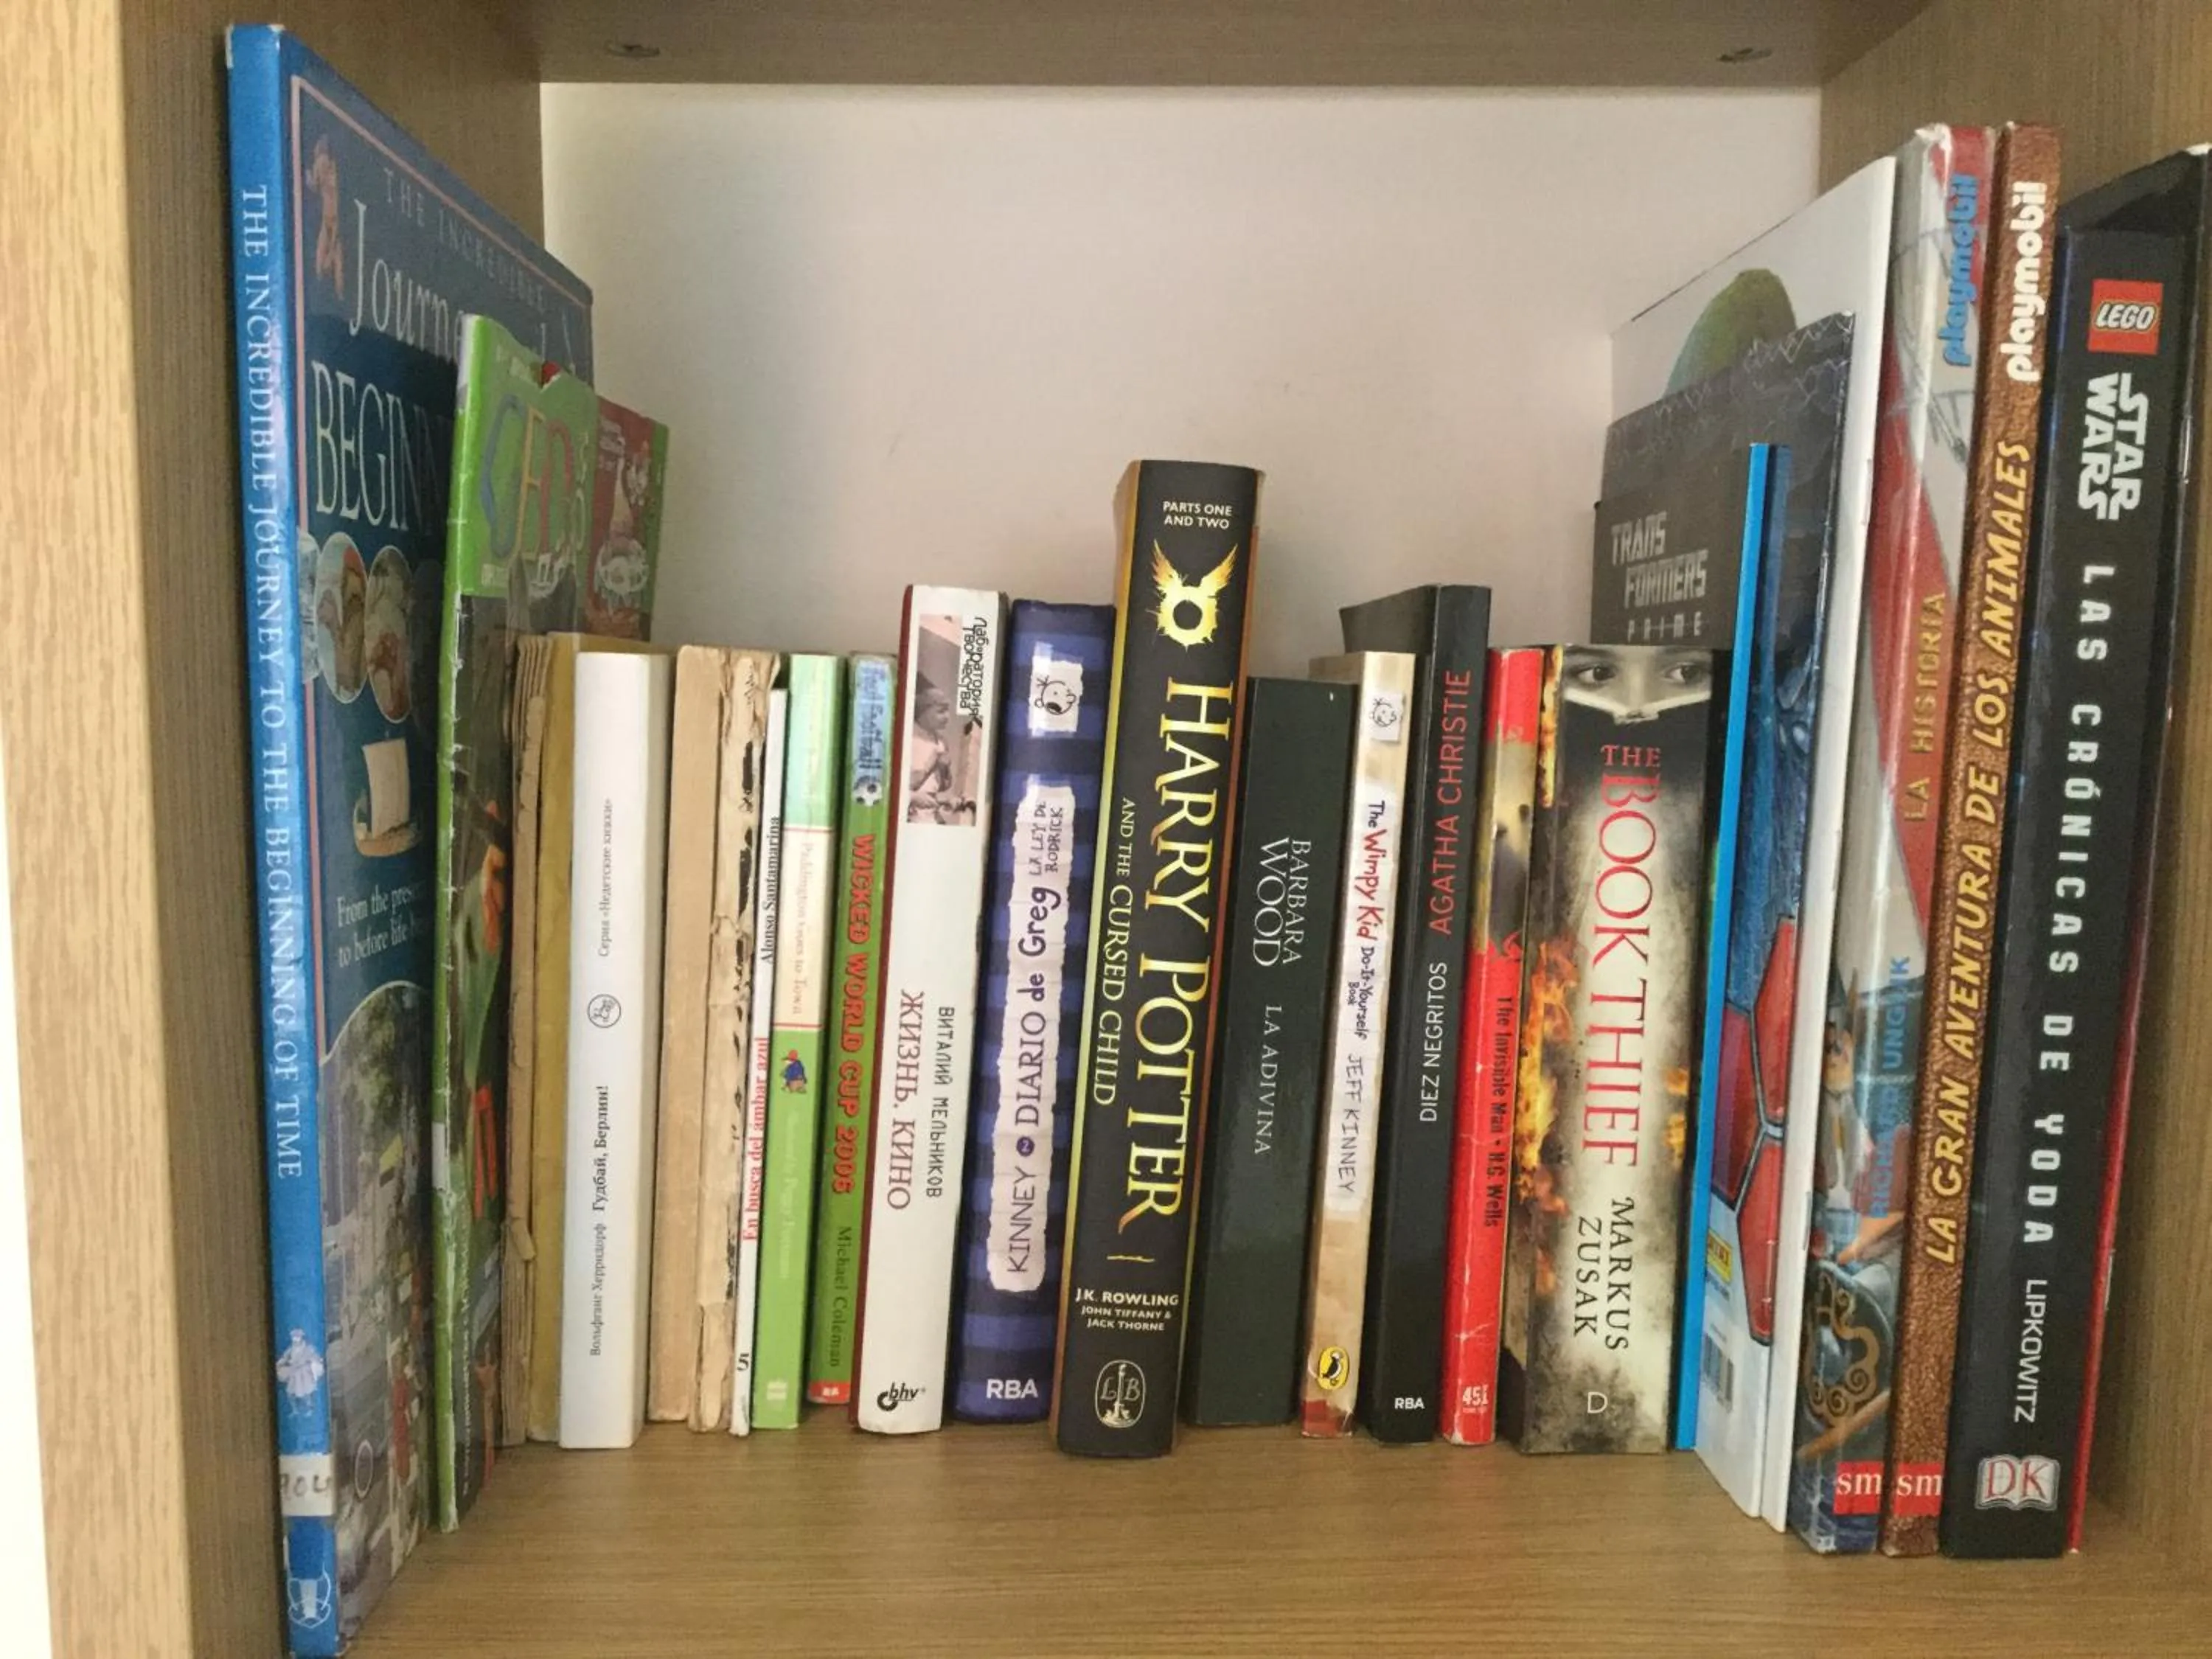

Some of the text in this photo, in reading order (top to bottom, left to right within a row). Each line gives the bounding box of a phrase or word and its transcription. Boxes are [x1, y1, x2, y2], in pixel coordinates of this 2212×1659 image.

[384, 167, 425, 227] THE
[2000, 181, 2047, 382] playmobil
[2095, 303, 2155, 330] LEGO
[2078, 372, 2118, 520] WARS
[2110, 372, 2149, 520] STAR
[1163, 501, 1233, 517] PARTS ONE
[1164, 515, 1230, 529] AND TWO
[242, 185, 302, 1179] THE INCREDIBLE JOURNEY TO THE BEGINNING OF TIME
[1904, 592, 1946, 822] LA HISTORIA
[1600, 744, 1661, 768] THE
[1144, 676, 1234, 933] HARRY
[1368, 800, 1385, 828] The
[1430, 670, 1471, 935] AGATHA CHRISTIE
[1045, 807, 1063, 873] RODRICK
[1354, 828, 1388, 901] Wimpy
[1591, 773, 1661, 968] BOOK
[1926, 441, 2030, 1264] LA GRAN AVENTURA DE LOS ANIMALES
[336, 894, 368, 928] From
[371, 884, 389, 914] the
[760, 816, 780, 964] Alonso Santamarina
[1018, 886, 1062, 958] Greg
[1253, 837, 1290, 967] WOOD
[1282, 839, 1312, 964] BARBARA
[1356, 905, 1384, 941] Kid
[2023, 565, 2115, 1243] LAS CRÓNICAS DE YODA
[337, 945, 352, 967] to
[353, 924, 389, 961] before
[1093, 796, 1136, 1106] AND THE CURSED CHILD
[832, 834, 876, 1194] WICKED WORLD CUP 2006
[1017, 972, 1045, 1003] de
[1347, 981, 1360, 1006] Book
[1497, 996, 1513, 1027] The
[1015, 1010, 1046, 1127] DIARIO
[1419, 961, 1448, 1122] DIEZ NEGRITOS
[1491, 1031, 1512, 1097] Invisible
[1582, 978, 1647, 1167] THIEF
[886, 989, 925, 1211] ЖИЗНЬ. КИНО
[926, 1006, 955, 1198] ВИТАЛИЙ МЕЛЬНИКОВ
[1118, 952, 1211, 1235] POTTER
[1253, 1005, 1283, 1155] LA ADIVINA
[594, 1085, 610, 1149] Берлин!
[742, 1037, 770, 1242] En busca del ámbar azul
[1338, 1053, 1364, 1193] JEFF KINNEY
[1489, 1101, 1507, 1134] Man
[592, 1152, 609, 1211] Гудбай,
[1483, 1183, 1506, 1228] Wells
[1007, 1165, 1037, 1273] KINNEY
[833, 1226, 852, 1290] Michael
[1573, 1215, 1602, 1338] ZUSAK
[1604, 1196, 1635, 1351] MARKUS
[830, 1295, 847, 1367] Coleman
[1081, 1304, 1112, 1316] JOHN
[1114, 1308, 1161, 1319] TIFFANY
[1087, 1318, 1165, 1332] JACK THORNE
[1102, 1291, 1180, 1307] ROWLING
[2014, 1279, 2048, 1423] LIPKOWITZ
[985, 1377, 1039, 1400] RBA
[1394, 1397, 1425, 1410] RBA
[1587, 1391, 1609, 1414] D
[1836, 1472, 1882, 1495] sm
[1896, 1474, 1942, 1496] sm
[1986, 1459, 2049, 1500] DK
